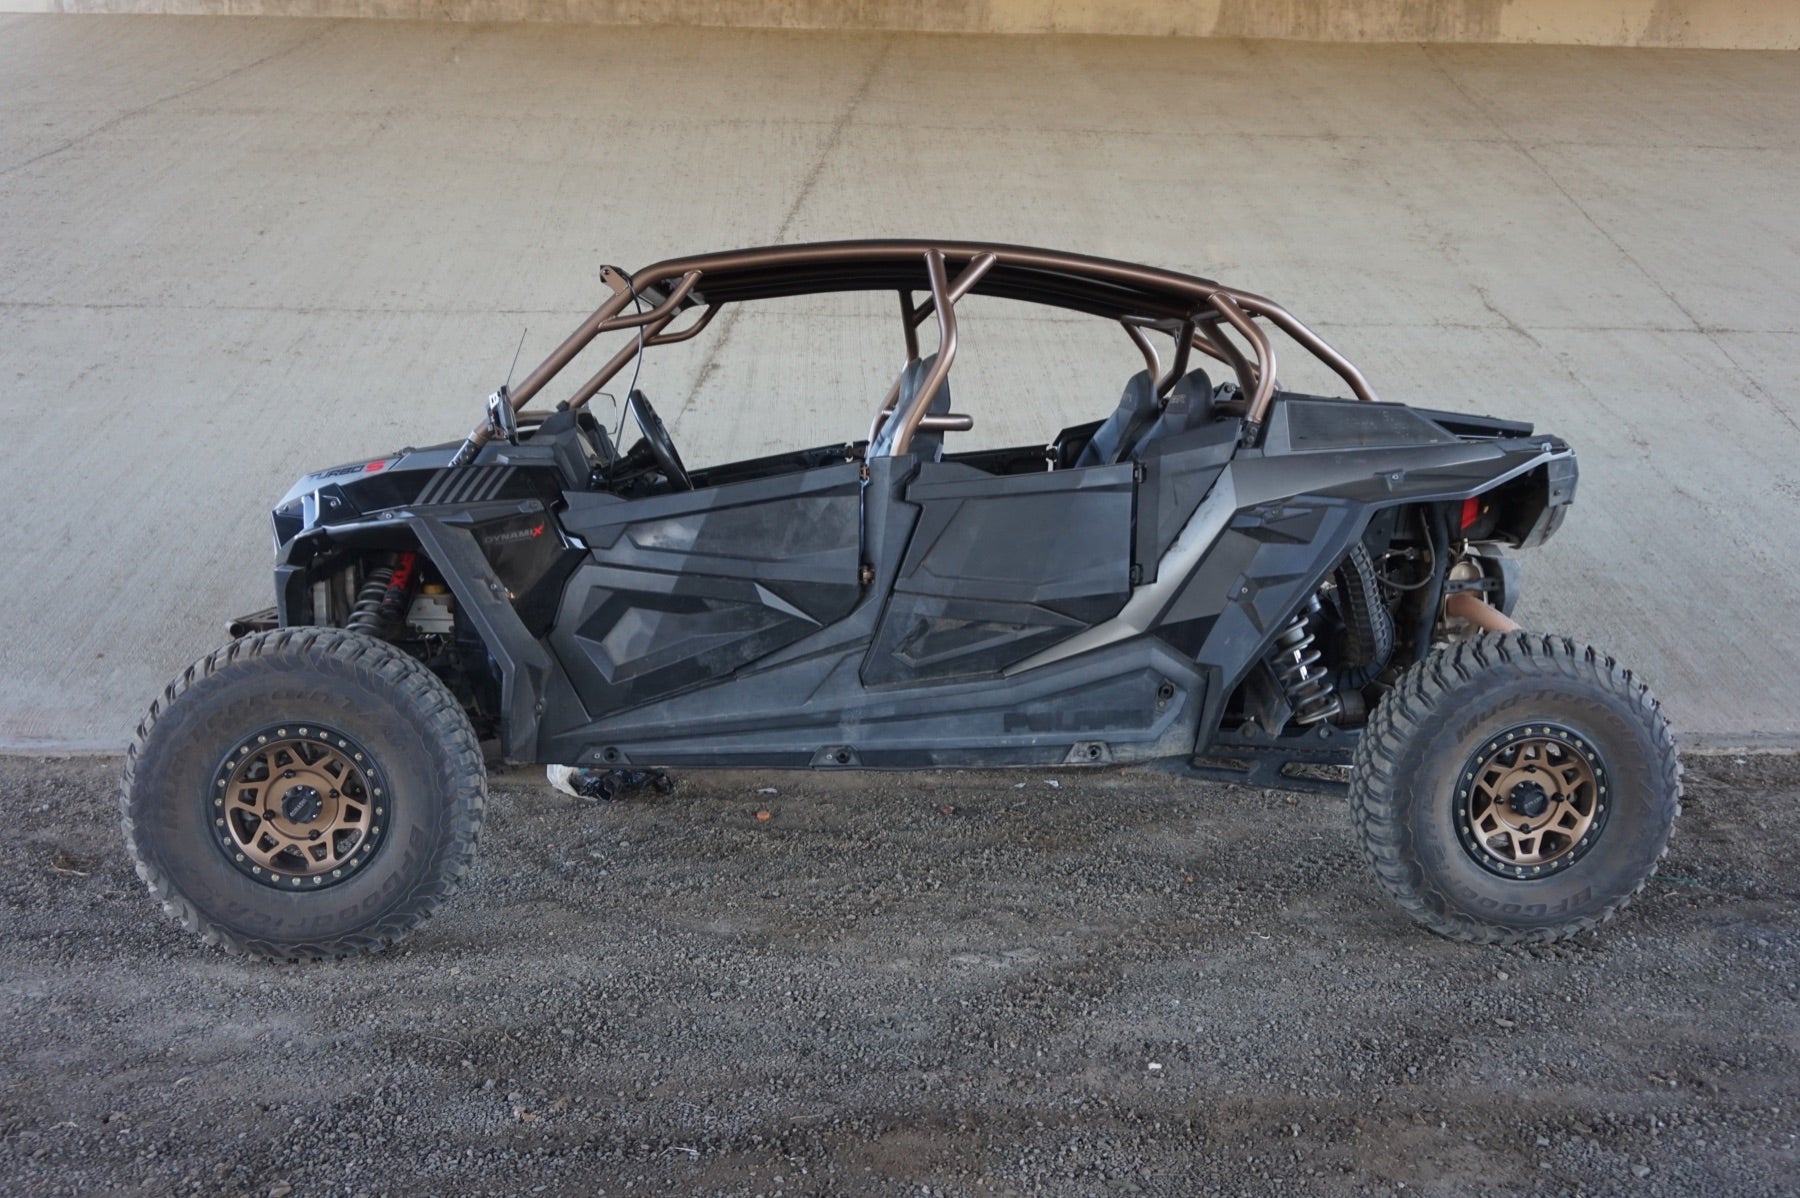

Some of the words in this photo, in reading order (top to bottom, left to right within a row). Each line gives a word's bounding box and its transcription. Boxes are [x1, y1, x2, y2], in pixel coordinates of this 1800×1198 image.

[308, 464, 366, 480] TURBO
[364, 459, 387, 473] S
[484, 523, 545, 544] DYNAMIX
